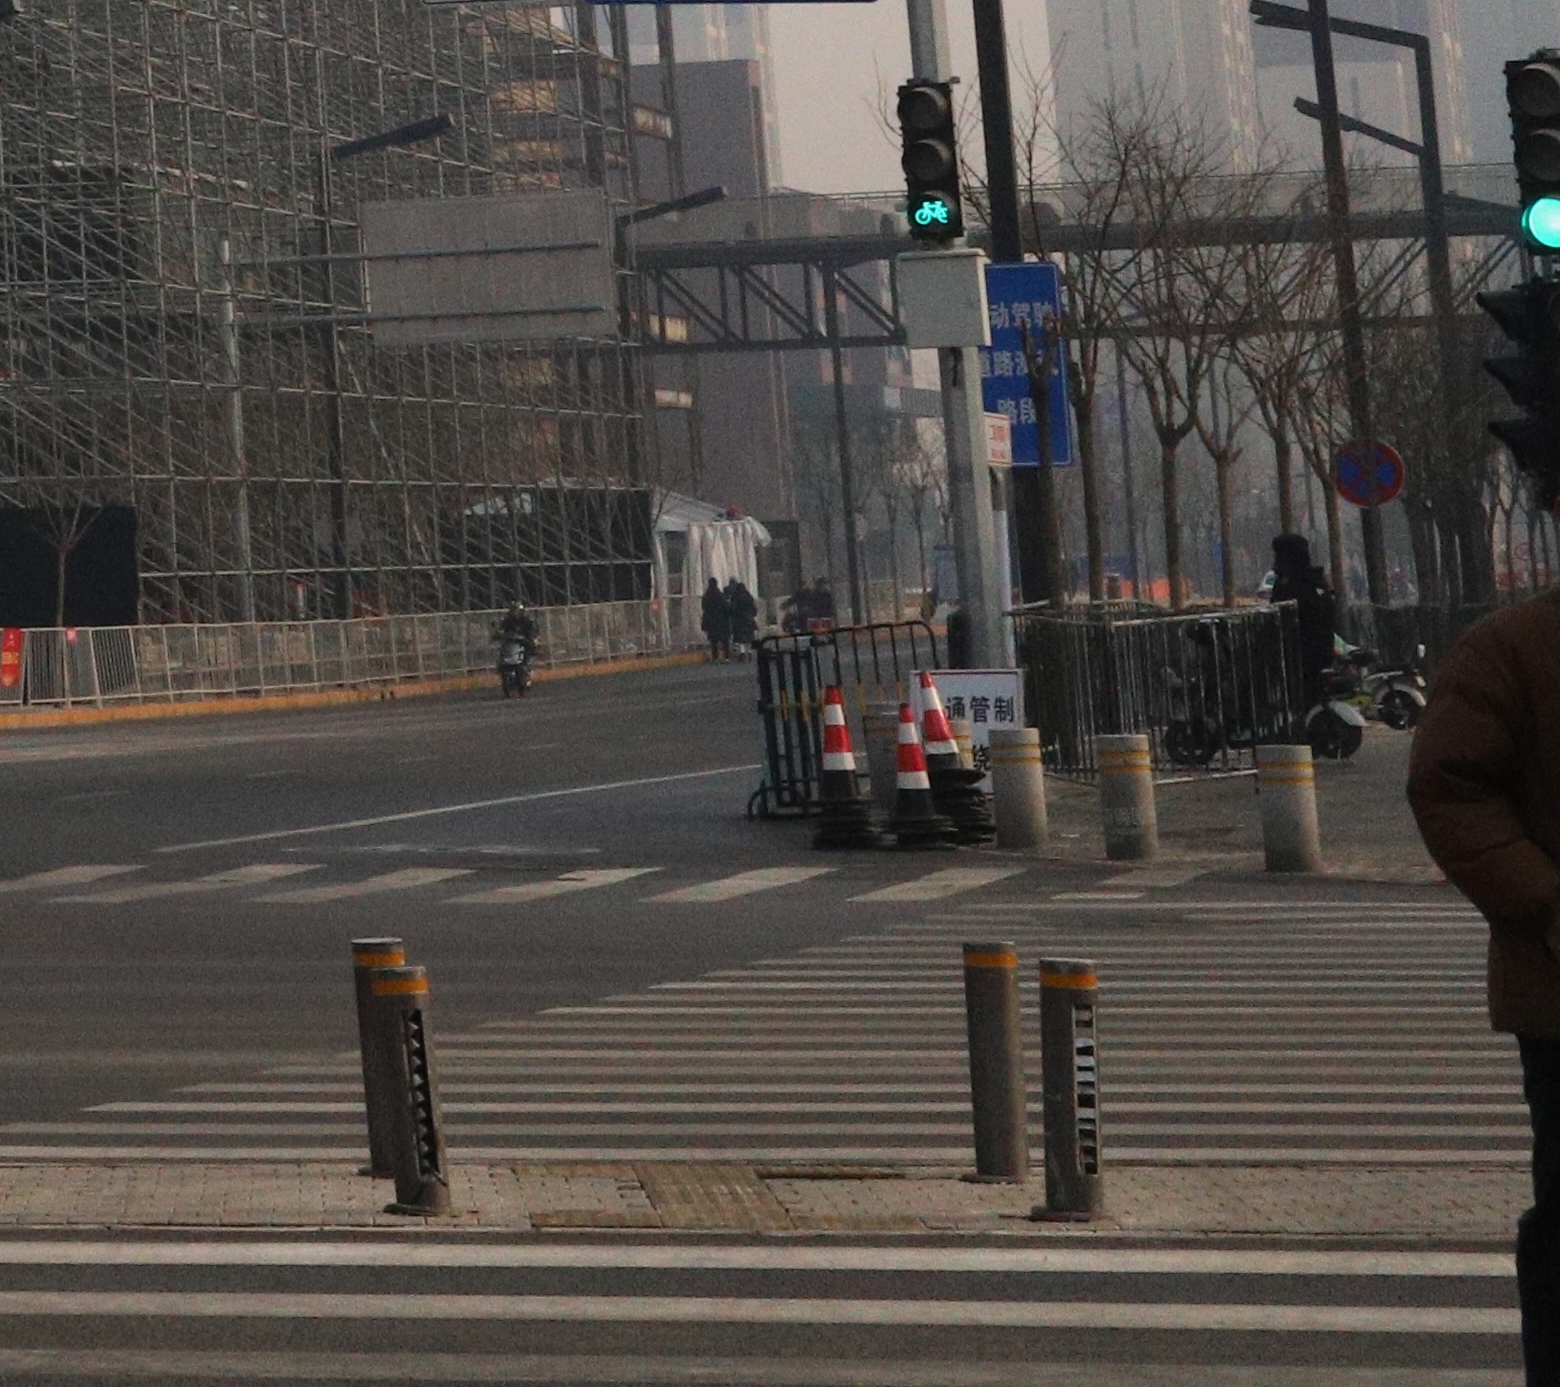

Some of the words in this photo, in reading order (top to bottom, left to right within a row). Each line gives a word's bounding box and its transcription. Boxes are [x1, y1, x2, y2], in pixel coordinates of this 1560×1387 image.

[989, 302, 1054, 329] 动驾驶
[945, 696, 1015, 724] 通管制
